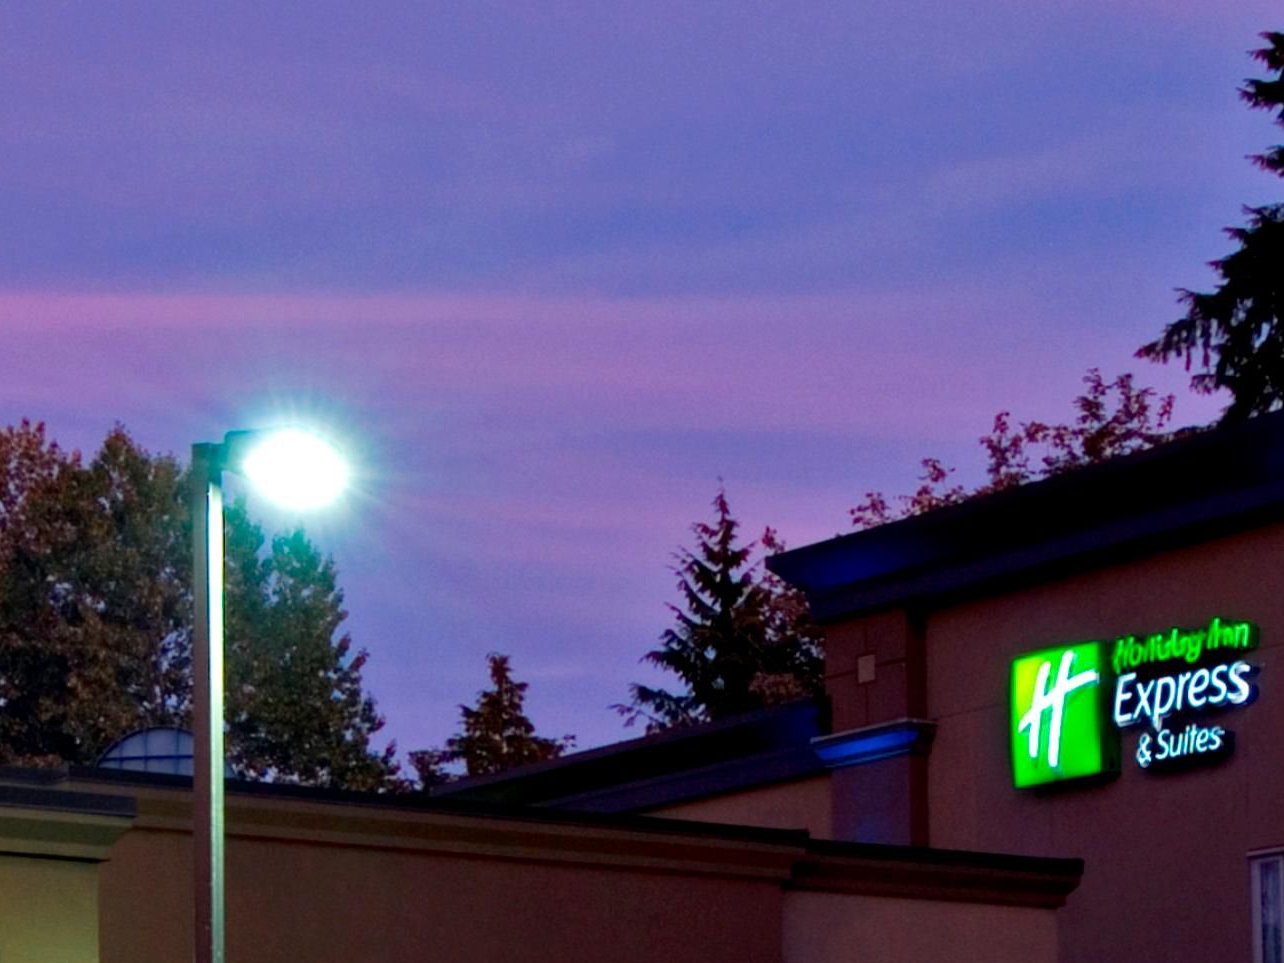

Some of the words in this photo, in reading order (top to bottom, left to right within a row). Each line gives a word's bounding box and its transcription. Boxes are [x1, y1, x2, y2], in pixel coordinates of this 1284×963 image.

[1112, 628, 1205, 673] Holiday
[1206, 617, 1250, 649] Inn
[1113, 660, 1251, 731] Express
[1136, 732, 1153, 768] &
[1155, 724, 1225, 760] Suites
